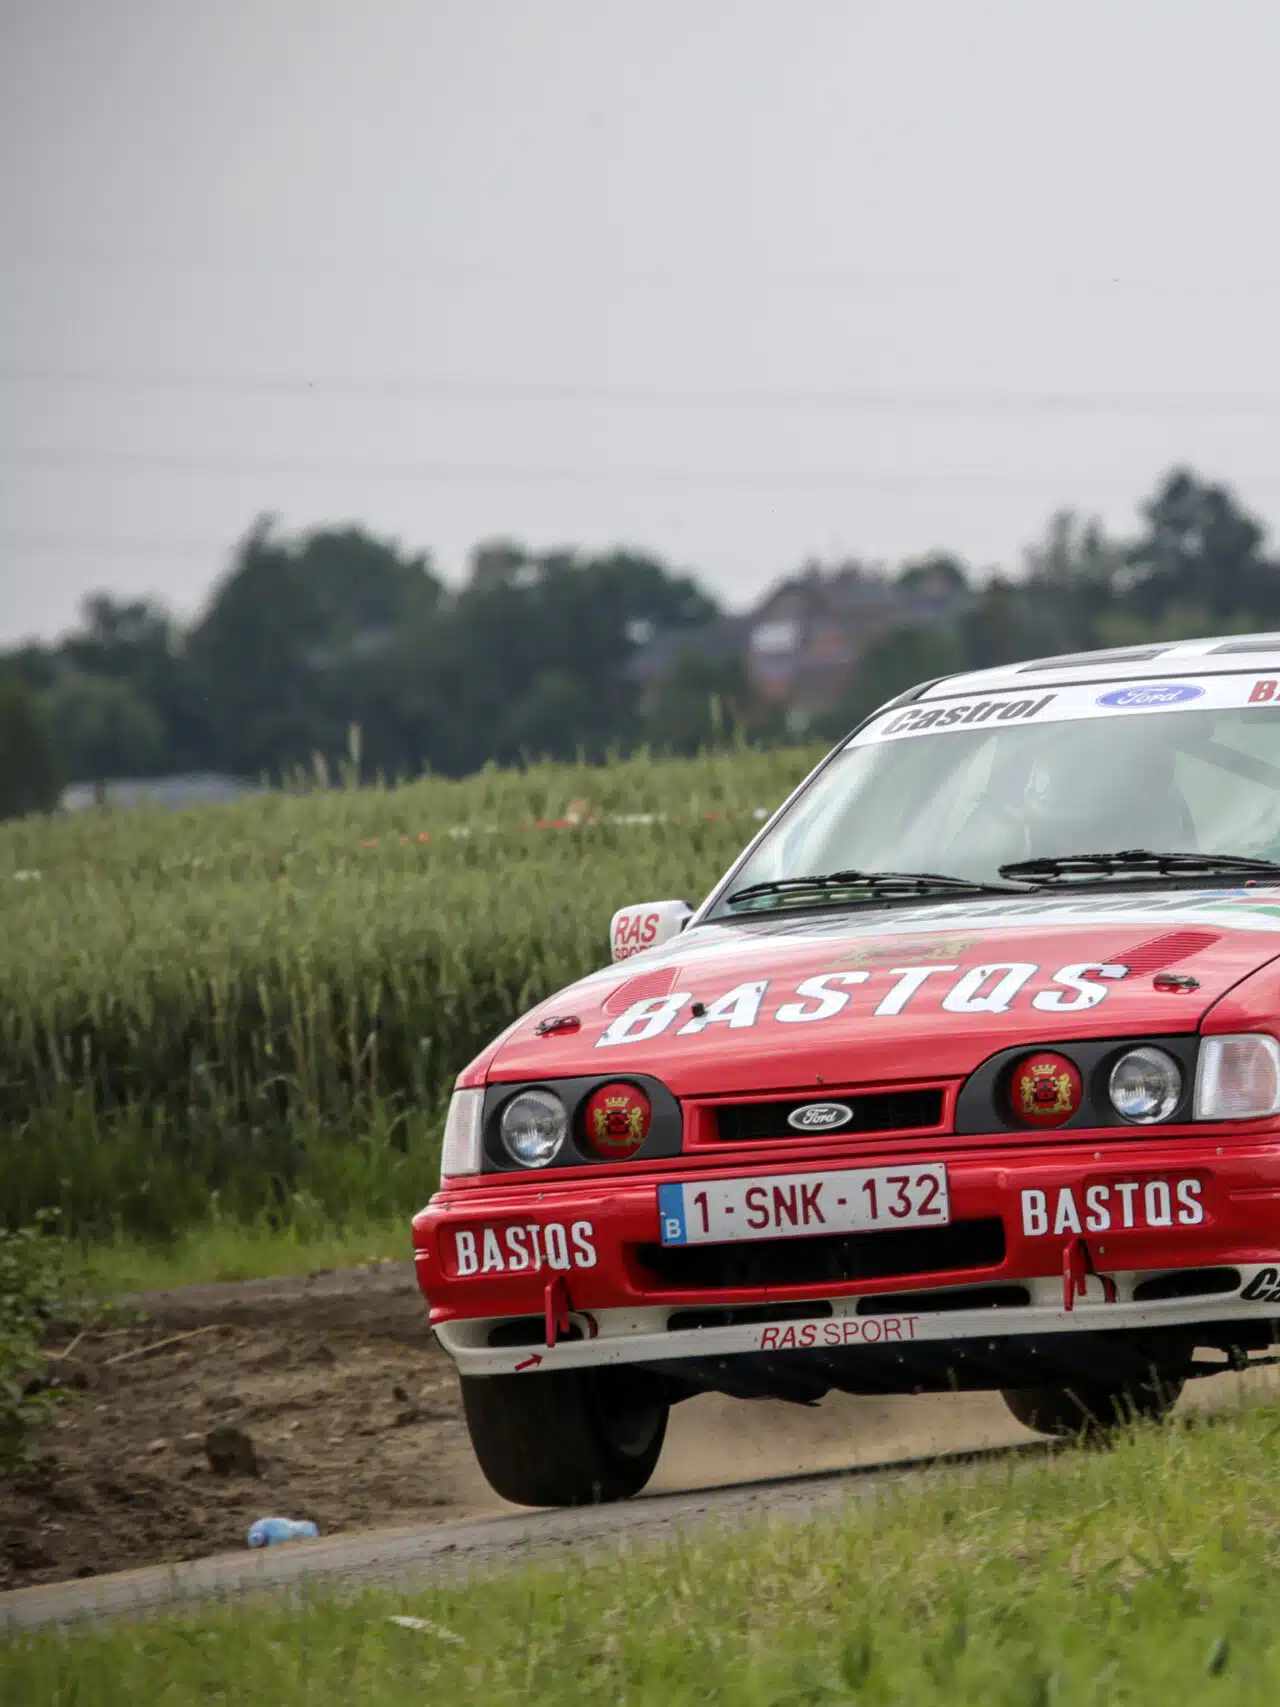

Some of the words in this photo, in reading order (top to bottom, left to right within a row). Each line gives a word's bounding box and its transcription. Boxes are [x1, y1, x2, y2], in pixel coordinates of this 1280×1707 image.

[1118, 686, 1180, 706] Ford
[881, 693, 1058, 735] Castrol
[615, 913, 660, 945] RAS
[804, 1105, 838, 1126] Ford
[666, 1218, 681, 1240] B
[760, 1322, 816, 1349] RAS
[824, 1316, 920, 1346] SPORT
